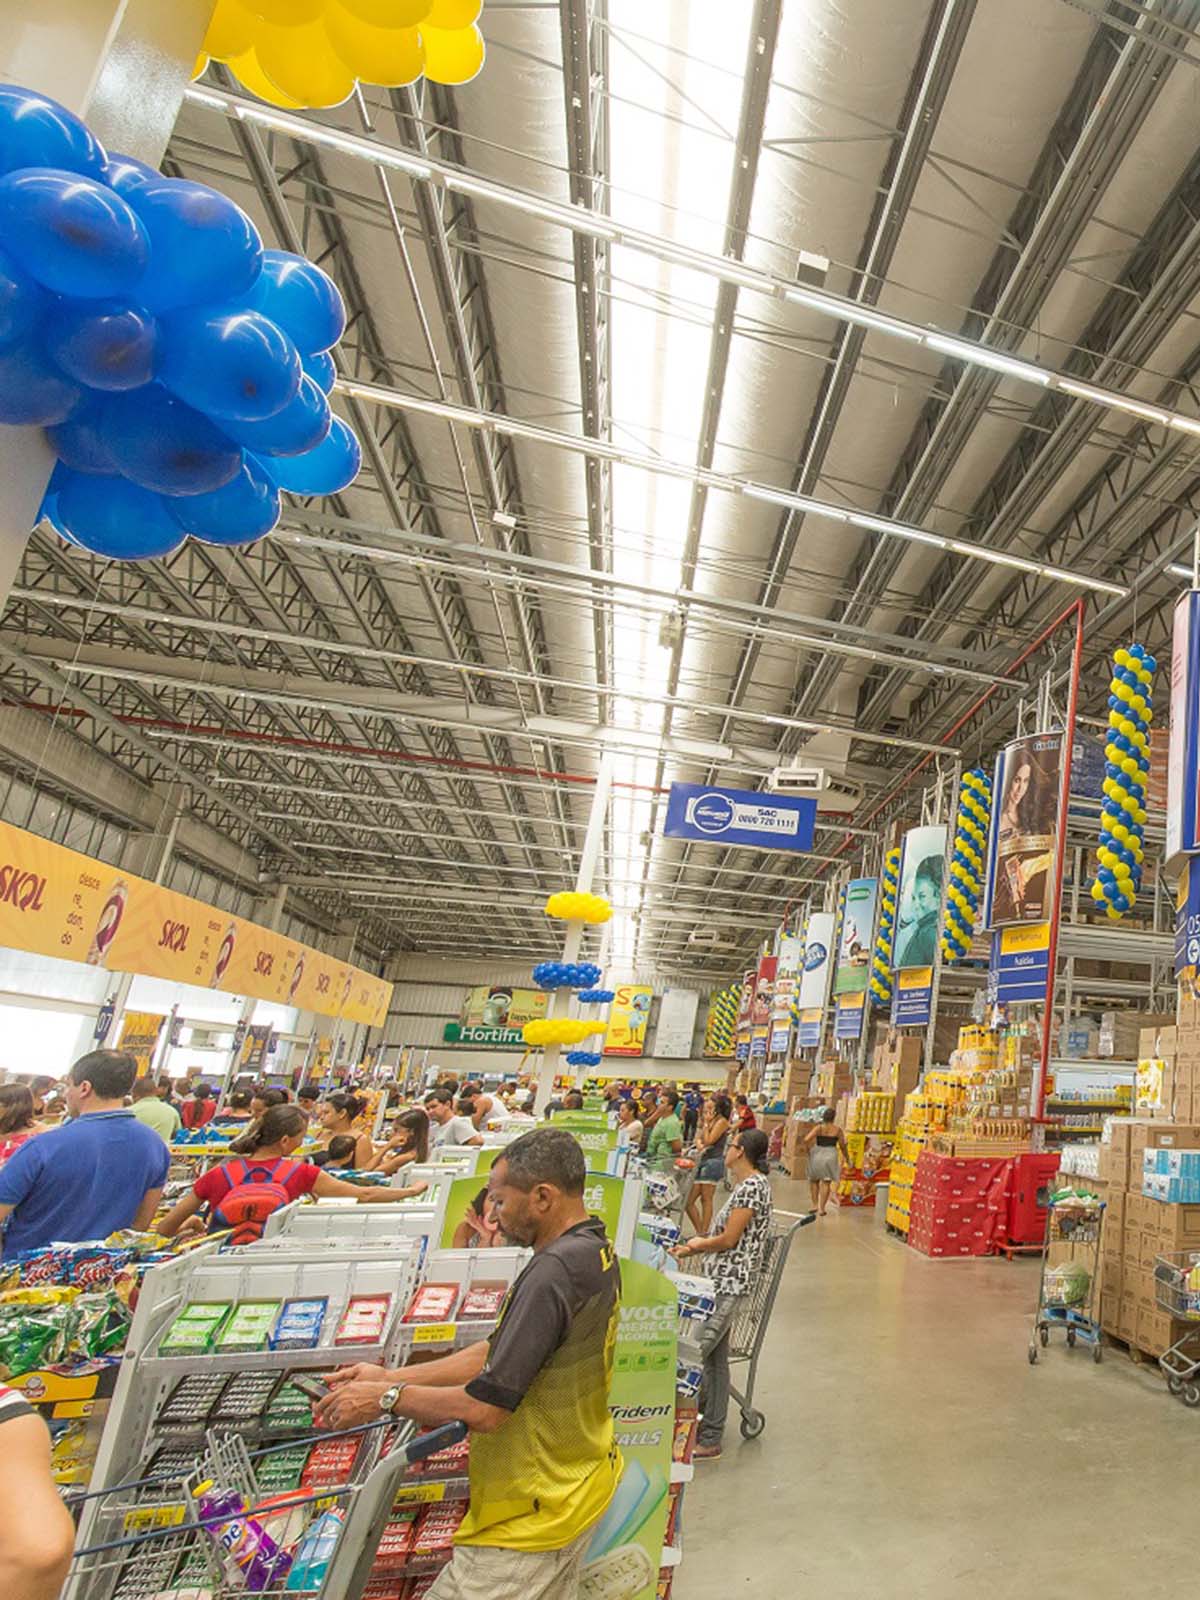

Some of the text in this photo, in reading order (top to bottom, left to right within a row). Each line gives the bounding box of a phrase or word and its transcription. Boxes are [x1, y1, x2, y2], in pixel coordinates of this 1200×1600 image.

[758, 809, 778, 818] SAC
[760, 817, 776, 826] 720
[0, 865, 48, 912] SKOL
[158, 919, 190, 952] SKOL
[619, 1301, 675, 1321] VOCÊ
[608, 1403, 673, 1418] Trident
[268, 1418, 302, 1427] HALLS
[614, 1431, 662, 1446] ALLS
